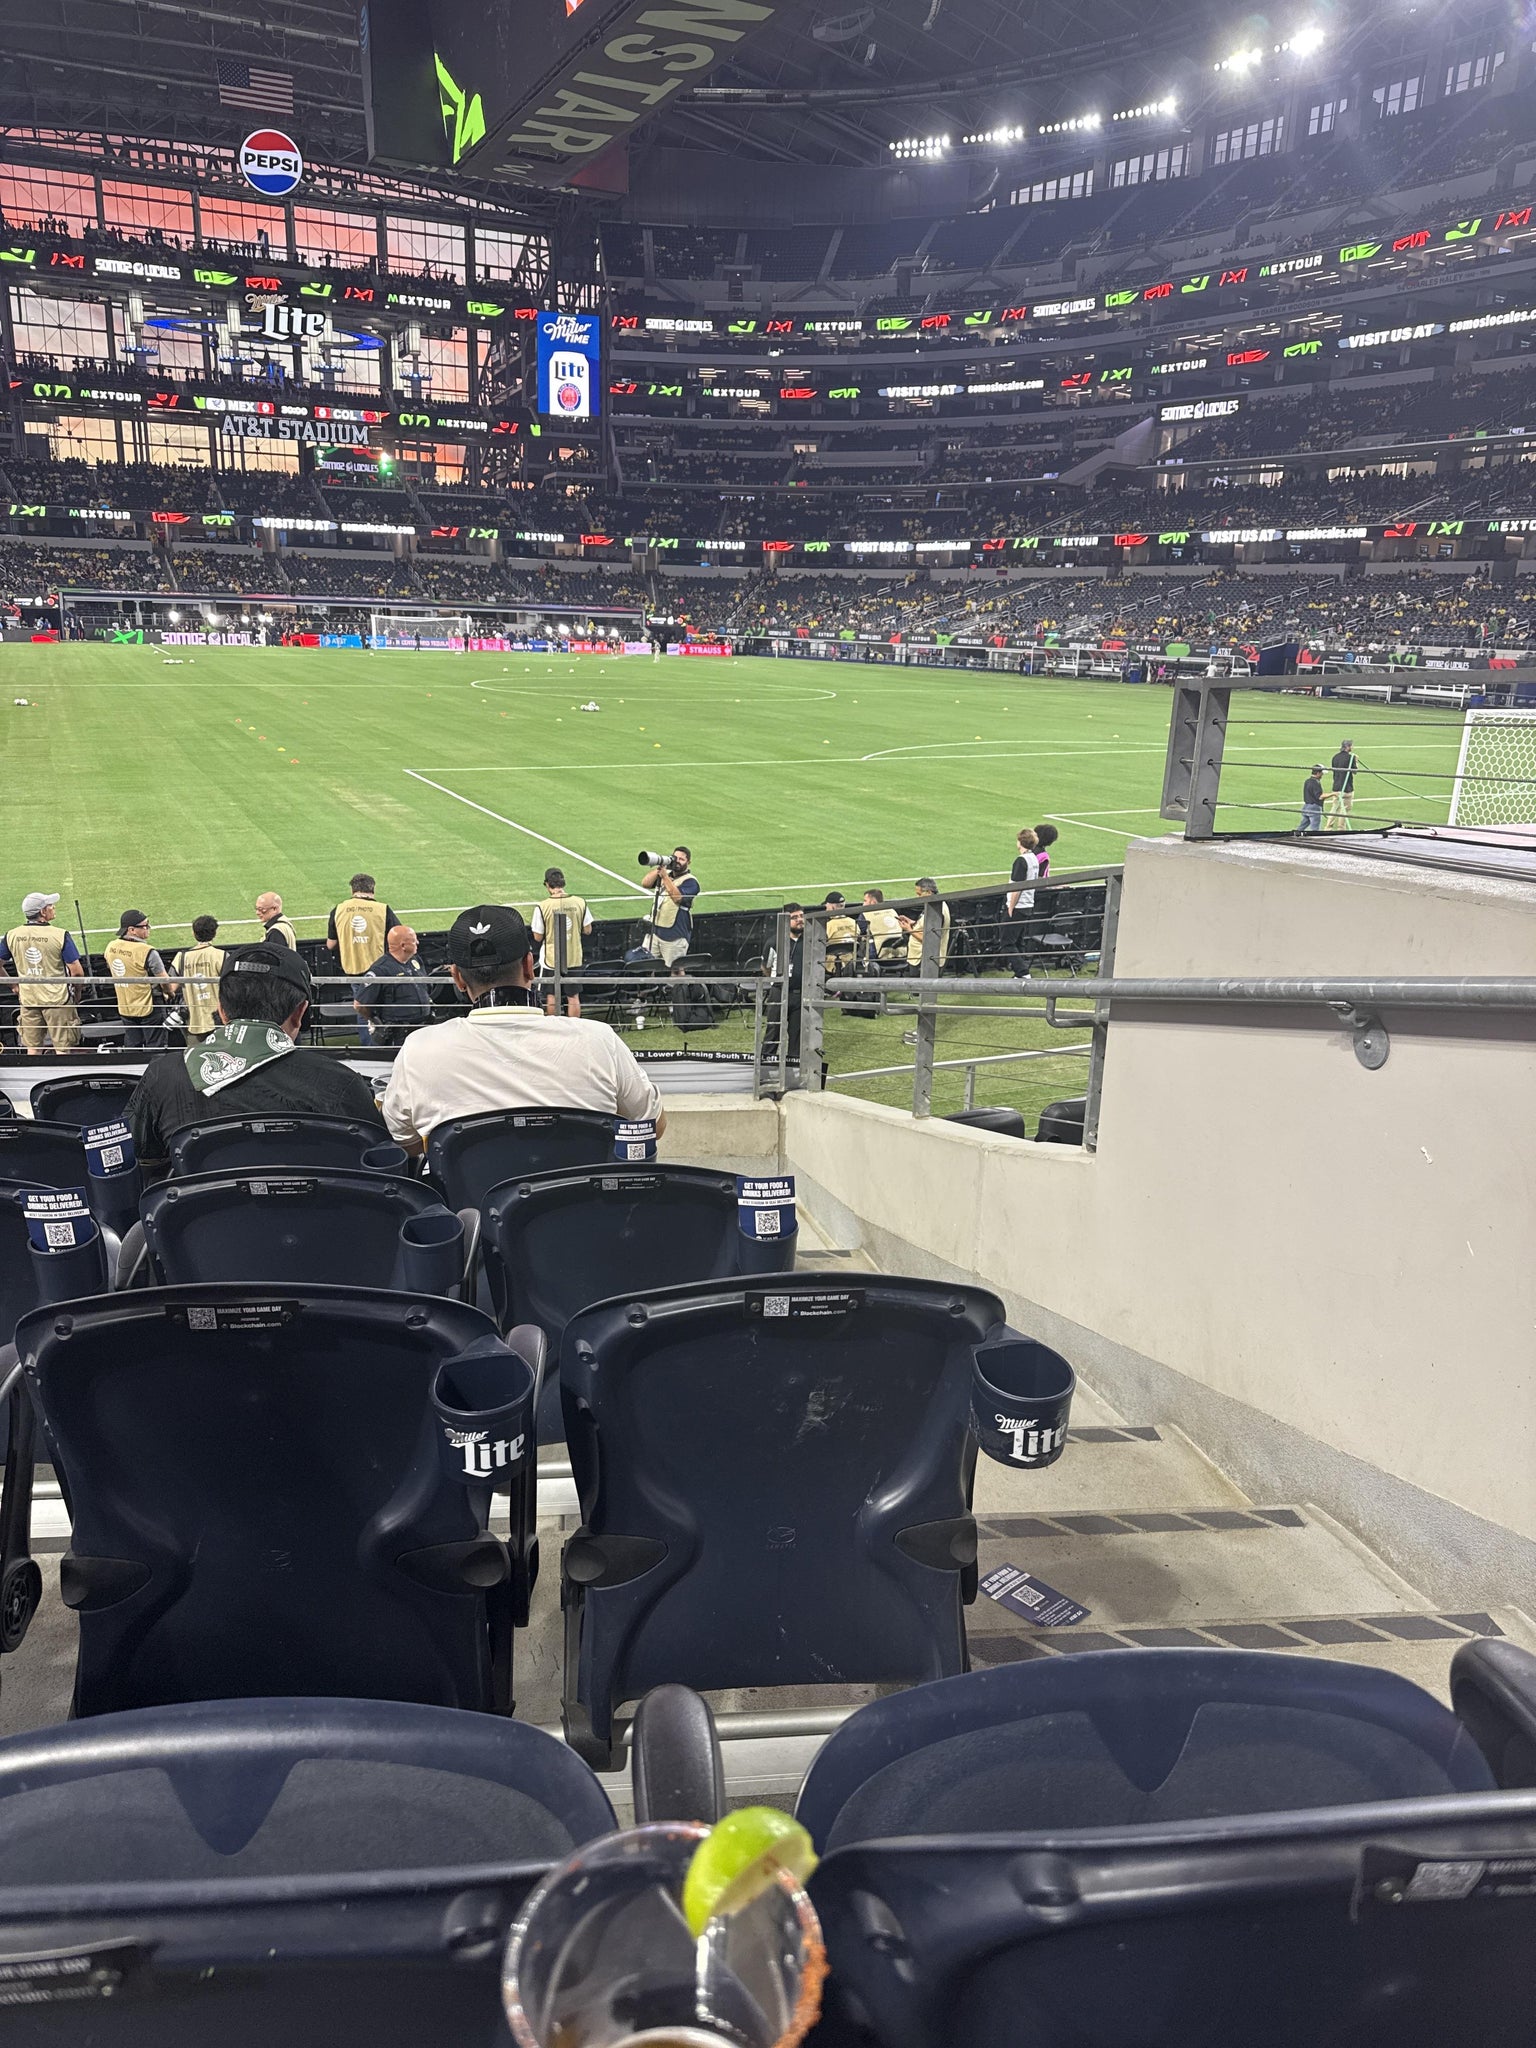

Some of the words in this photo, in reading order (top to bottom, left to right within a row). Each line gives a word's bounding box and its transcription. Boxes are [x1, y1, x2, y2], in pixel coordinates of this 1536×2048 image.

[244, 152, 298, 173] PEPSI
[144, 263, 181, 280] LOCALES
[1259, 255, 1323, 277] MEXTOUR
[1439, 273, 1463, 285] HALEY
[387, 293, 451, 310] MEXTOUR
[262, 303, 325, 341] Lite
[556, 315, 577, 325] IT'S
[804, 320, 863, 331] MEXTOUR
[543, 323, 592, 341] Miller
[1348, 331, 1390, 349] VISIT
[1390, 327, 1411, 342] US
[1411, 323, 1435, 340] AT
[565, 334, 590, 345] TIME
[554, 361, 584, 381] Lite
[1151, 359, 1207, 375] MEXTOUR
[80, 389, 142, 402] MEXTOUR
[702, 389, 760, 397] MEXTOUR
[887, 386, 921, 398] VISIT
[922, 385, 939, 397] US
[940, 384, 957, 396] AT
[227, 400, 256, 413] MEX
[1204, 400, 1239, 417] LOCALES
[333, 409, 356, 421] COL
[222, 415, 275, 438] AT&T
[279, 420, 370, 445] STADIUM
[437, 418, 488, 431] MEXTOUR
[69, 508, 131, 520] MEXTOUR
[261, 517, 295, 529] VISIT
[314, 519, 330, 531] AT
[515, 531, 564, 543] MEXTOUR
[1053, 536, 1099, 547] MEXTOUR
[1208, 530, 1240, 543] VISIT
[1240, 530, 1257, 542] US
[1257, 529, 1276, 542] AT
[696, 540, 746, 550] MEXTOUR
[689, 646, 721, 655] STRAUSS
[1354, 655, 1373, 664] AT&T
[26, 967, 44, 976] AT&T
[715, 1051, 740, 1060] South
[87, 1128, 97, 1136] GET
[97, 1126, 109, 1135] YOUR
[109, 1123, 120, 1132] FOOD
[743, 1182, 754, 1190] GET
[754, 1182, 768, 1190] YOUR
[769, 1181, 783, 1189] FOOD
[28, 1194, 39, 1203] GET
[40, 1194, 56, 1203] YOUR
[56, 1193, 72, 1202] FOOD
[27, 1202, 48, 1210] DRINKS
[994, 1413, 1040, 1433] Miller
[444, 1427, 490, 1446] Miller
[1008, 1420, 1068, 1463] Lite
[459, 1432, 525, 1479] Lite
